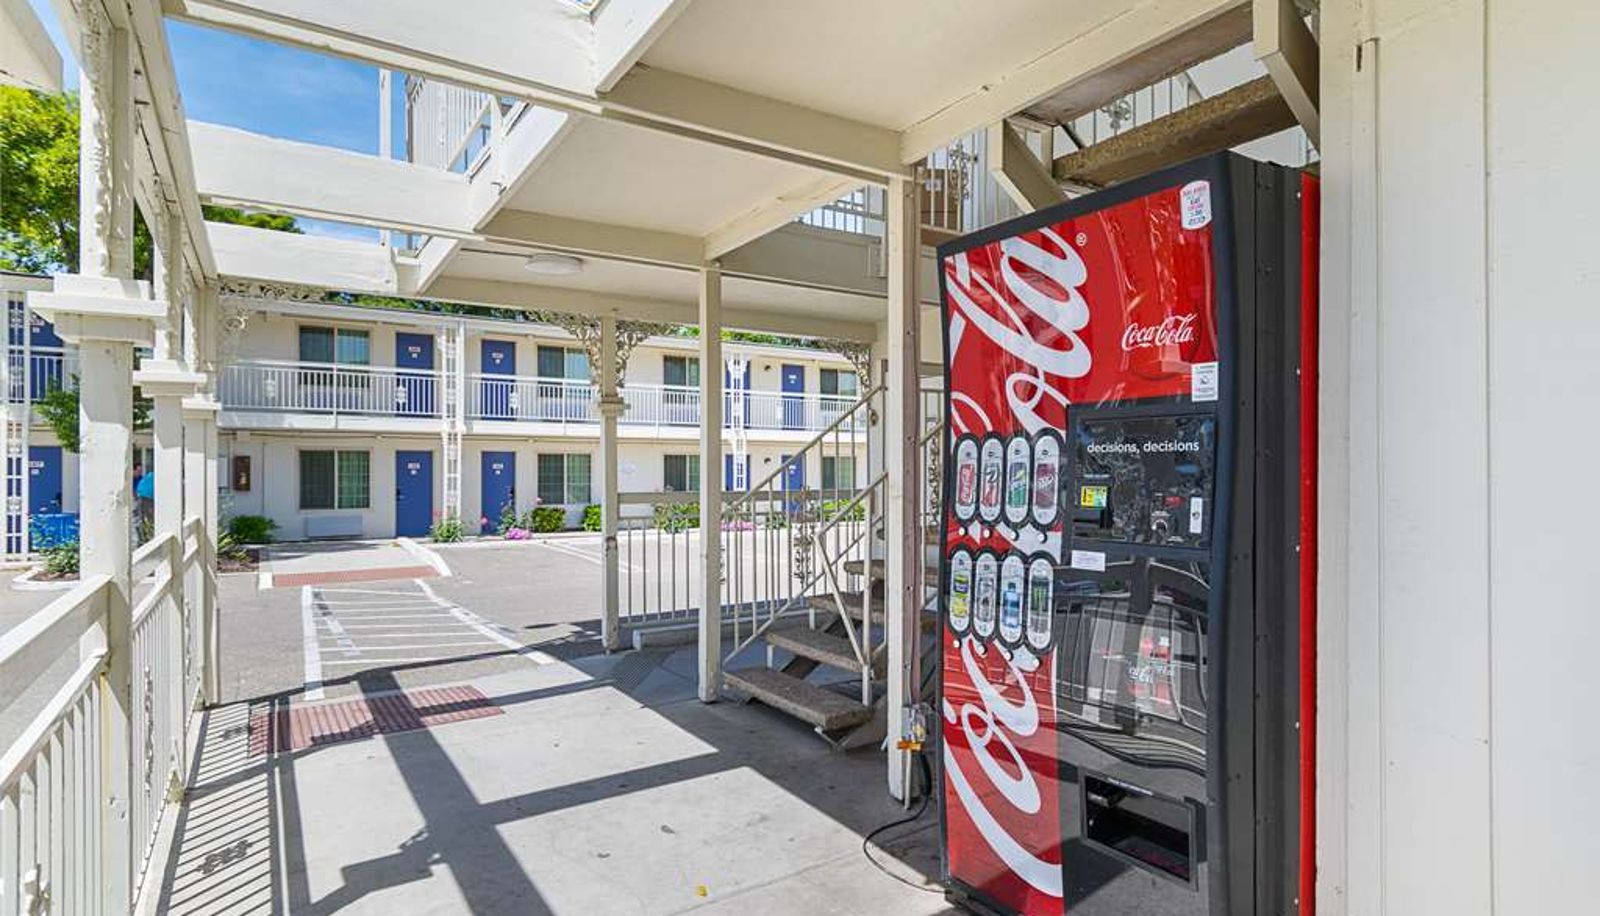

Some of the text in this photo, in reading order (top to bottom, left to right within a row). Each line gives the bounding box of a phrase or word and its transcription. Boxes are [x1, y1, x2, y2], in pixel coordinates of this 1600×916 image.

[1121, 313, 1197, 351] Coca-Cola
[1087, 440, 1200, 454] decisions, decisions
